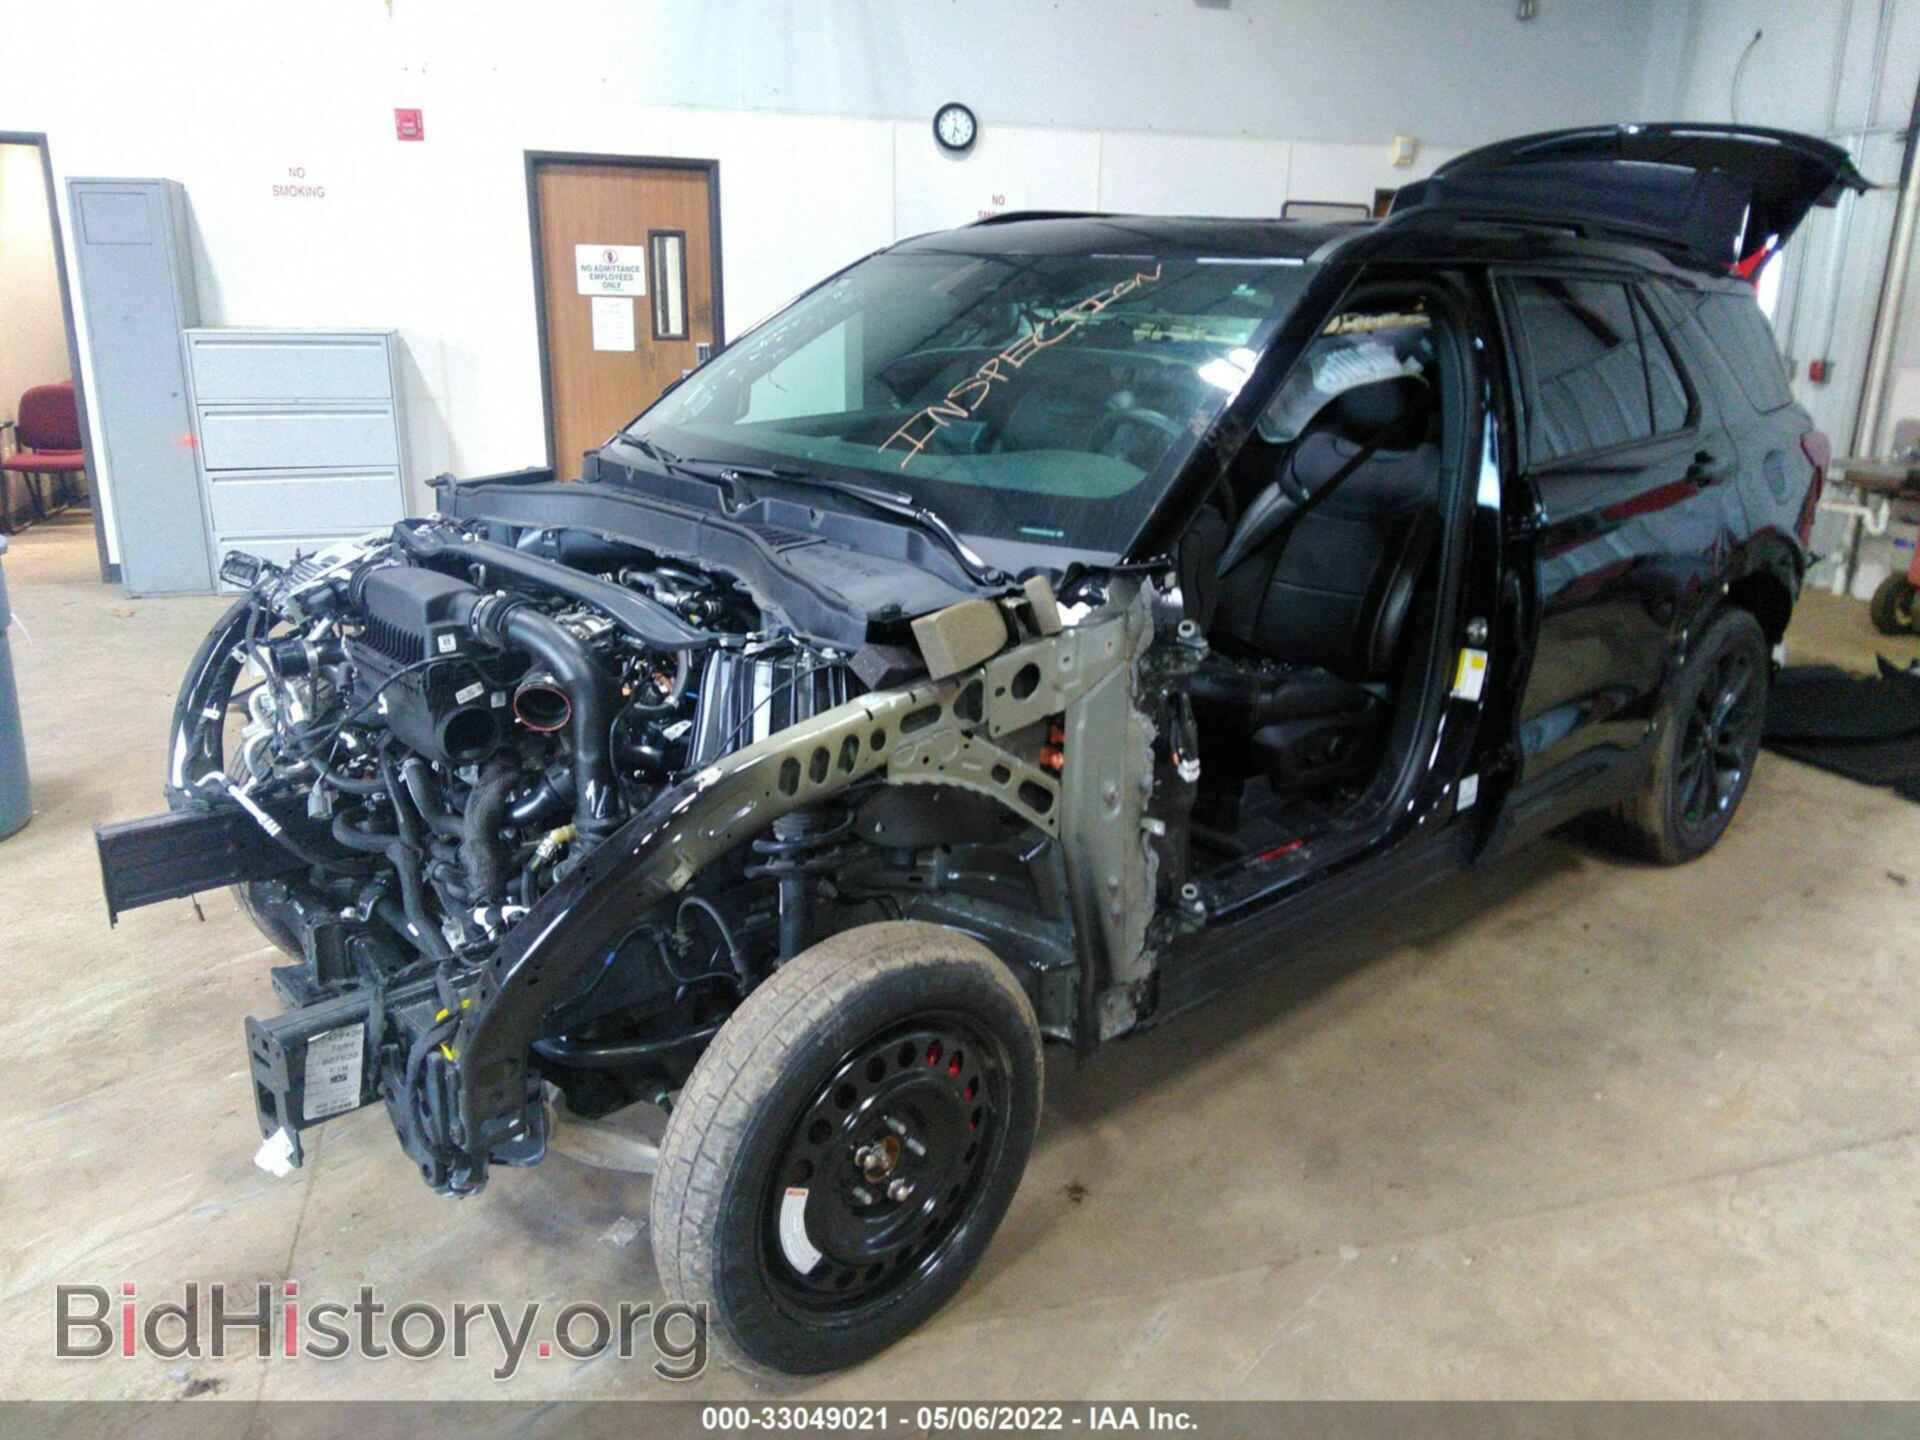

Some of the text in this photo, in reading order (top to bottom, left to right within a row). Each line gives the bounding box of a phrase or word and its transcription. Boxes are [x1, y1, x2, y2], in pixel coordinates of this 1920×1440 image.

[288, 166, 306, 179] NO
[272, 184, 326, 199] SMOKING
[991, 194, 1006, 206] NO
[581, 264, 640, 273] NO ADMITTANCE
[590, 273, 634, 281] EMPLOYEES
[602, 281, 621, 289] ONLY
